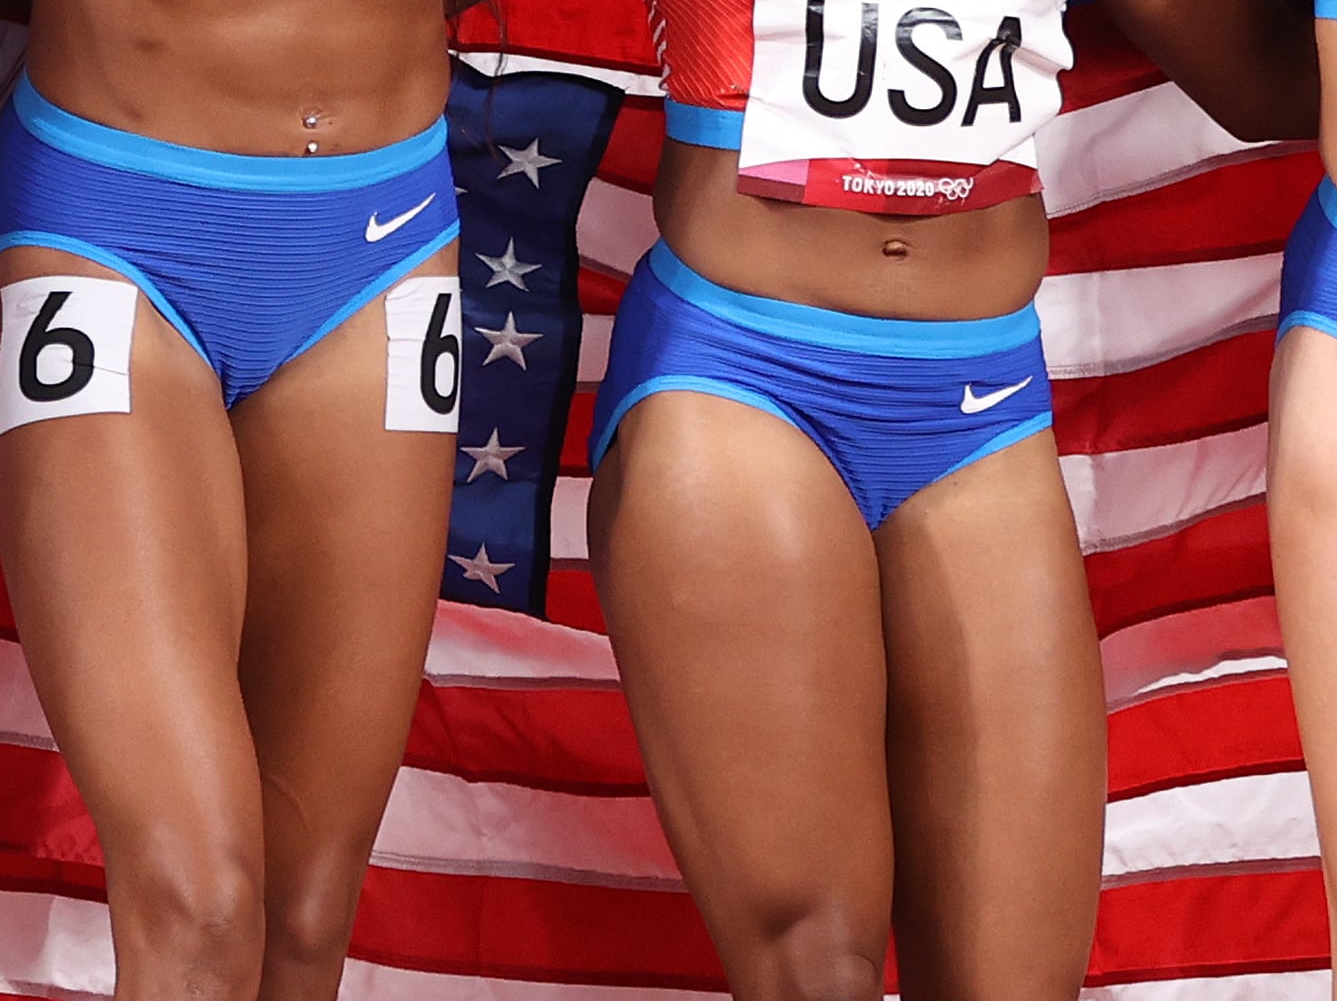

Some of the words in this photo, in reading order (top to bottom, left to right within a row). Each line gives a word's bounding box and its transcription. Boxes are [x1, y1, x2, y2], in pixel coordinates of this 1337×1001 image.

[841, 175, 895, 196] TOKYO
[896, 181, 935, 197] 2020
[18, 290, 96, 403] 6
[420, 292, 460, 416] 6
